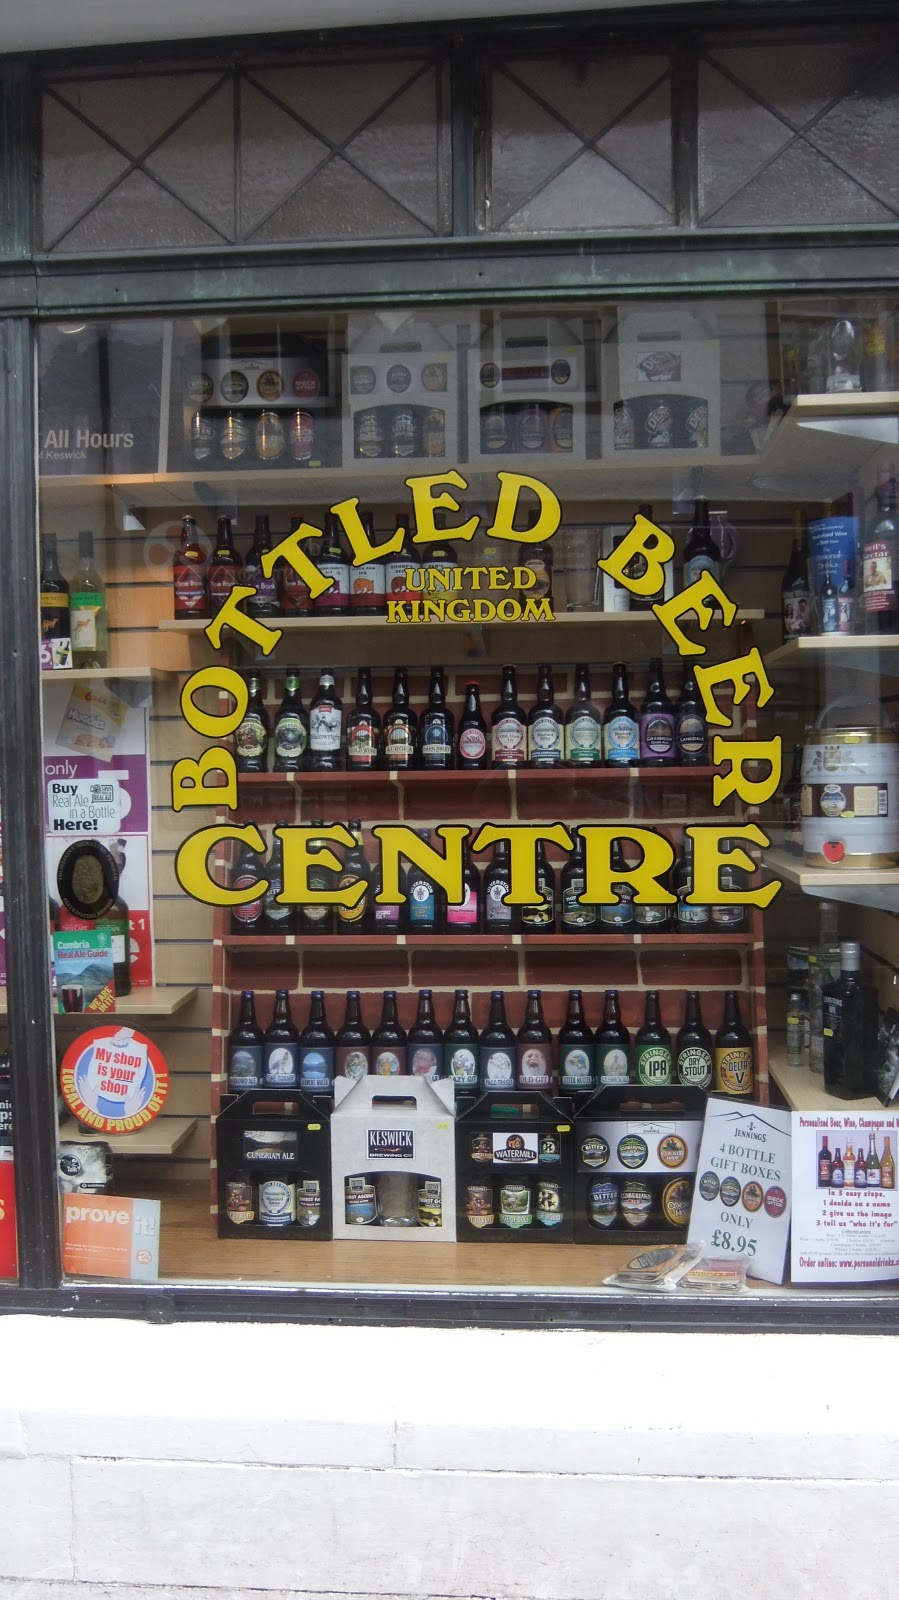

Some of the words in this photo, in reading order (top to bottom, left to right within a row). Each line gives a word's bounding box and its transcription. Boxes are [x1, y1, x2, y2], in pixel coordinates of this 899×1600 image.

[43, 429, 69, 449] All
[76, 429, 134, 449] Hours
[46, 449, 87, 460] Keswick
[404, 566, 537, 591] UNITED
[386, 598, 556, 623] KINGDOM
[171, 469, 562, 812] BOTTLED
[597, 512, 783, 808] BEER
[45, 759, 78, 778] only
[52, 783, 78, 796] Buy
[52, 795, 72, 808] Real
[73, 794, 89, 807] Ale
[69, 808, 78, 818] in
[80, 808, 86, 819] a
[88, 805, 116, 819] Bottle
[53, 818, 98, 831] Here!
[174, 822, 783, 908] CENTRE
[409, 880, 434, 894] ULVERSTON
[57, 939, 90, 950] Cumbria
[57, 951, 74, 959] Real
[74, 950, 87, 959] Ale
[87, 949, 109, 958] Guide
[88, 997, 101, 1011] WE
[97, 985, 113, 1003] ARE
[95, 1047, 112, 1062] My
[113, 1052, 142, 1068] shop
[679, 1048, 711, 1066] STRINGERS
[688, 1057, 701, 1067] DRY
[97, 1063, 107, 1076] is
[110, 1067, 136, 1082] your
[648, 1059, 667, 1077] IPA
[684, 1065, 706, 1076] STOUT
[728, 1060, 748, 1072] DELTA
[467, 1074, 476, 1083] GIT
[735, 1071, 744, 1084] V
[100, 1080, 128, 1096] shop
[62, 1068, 82, 1109] LOCAL
[77, 1107, 104, 1128] AND
[106, 1111, 153, 1131] PROUD
[147, 1095, 164, 1112] OF
[800, 1116, 829, 1127] Personalised
[859, 1117, 885, 1131] Champagne
[886, 1117, 895, 1128] and
[370, 1130, 413, 1147] KESWICK
[734, 1127, 767, 1143] JENNINGS
[246, 1151, 281, 1159] CUMBRIAN
[281, 1152, 295, 1160] ALE
[495, 1150, 536, 1159] WATERMILL
[719, 1142, 726, 1153] 4
[728, 1144, 776, 1164] BOTTLE
[710, 1156, 739, 1172] GIFT
[740, 1162, 781, 1182] BOXES
[593, 1192, 618, 1200] BITTER
[864, 1190, 886, 1199] steps.
[829, 1199, 852, 1207] decide
[66, 1205, 130, 1225] prove
[135, 1215, 156, 1236] it!
[720, 1211, 753, 1229] ONLY
[829, 1210, 844, 1218] give
[871, 1211, 892, 1219] image
[870, 1220, 880, 1228] it's
[710, 1228, 757, 1257] £8.95
[799, 1256, 816, 1268] Order
[818, 1257, 838, 1268] online:
